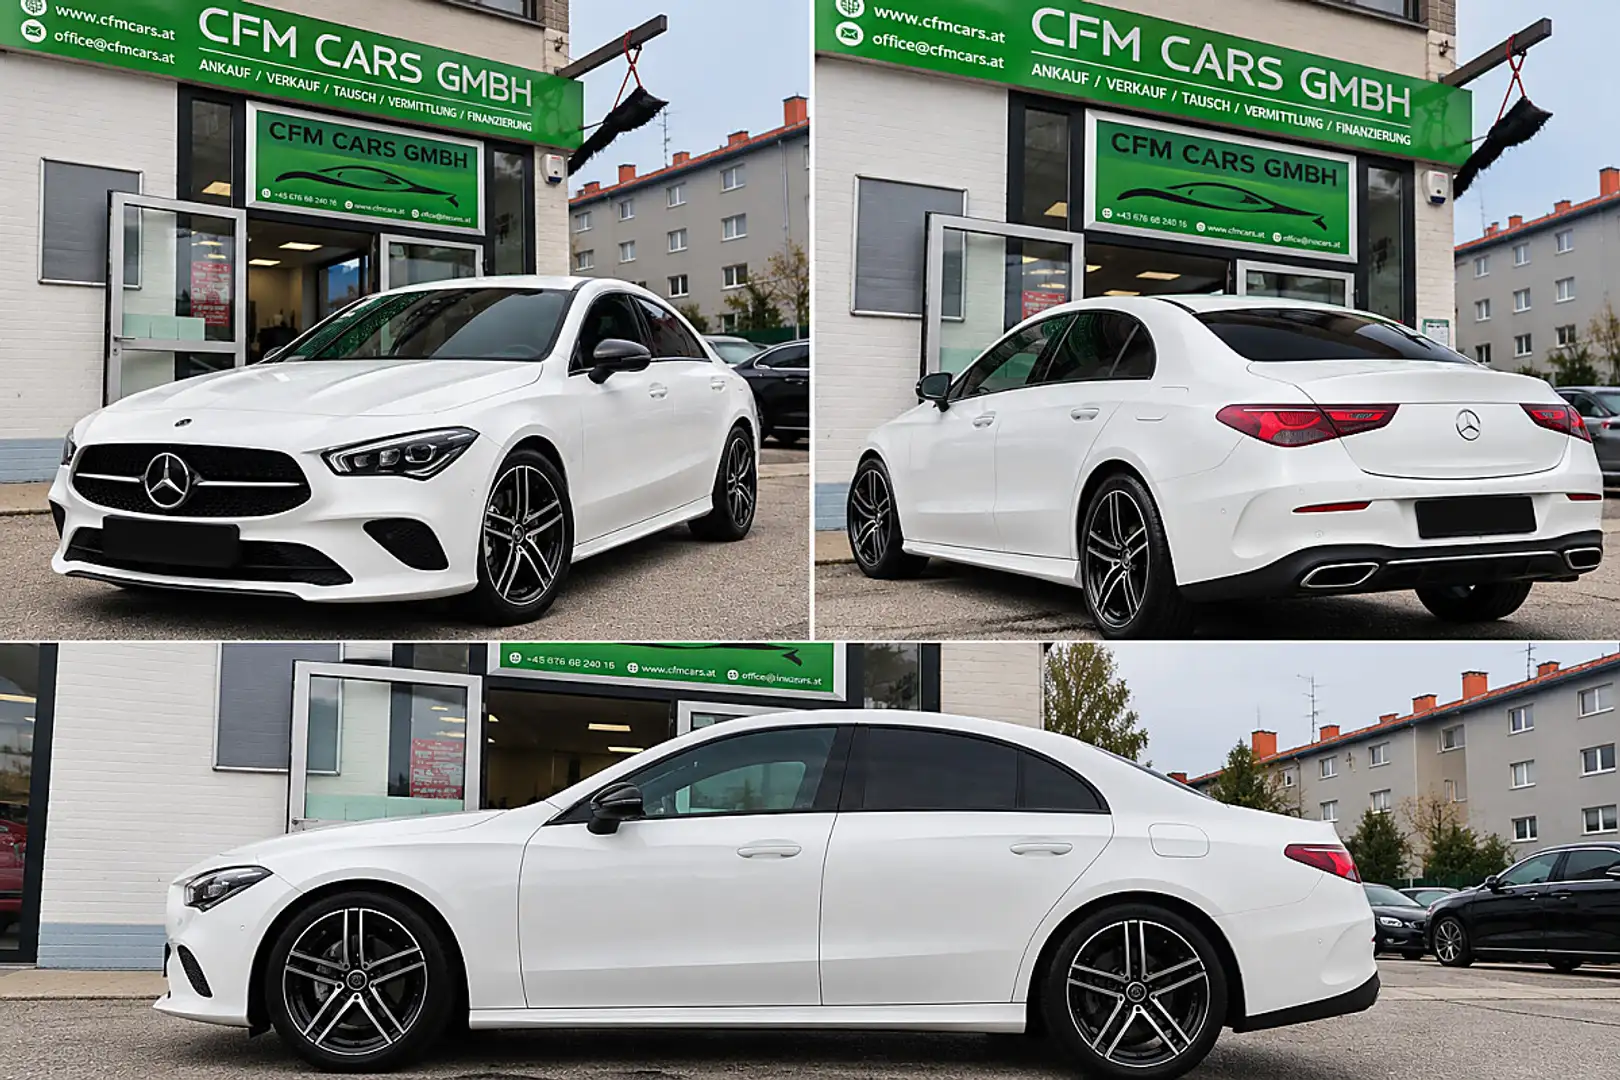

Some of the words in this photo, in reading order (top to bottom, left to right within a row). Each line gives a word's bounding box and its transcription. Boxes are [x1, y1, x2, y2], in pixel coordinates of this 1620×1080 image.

[56, 5, 175, 40] www.cfmcars.at
[874, 6, 1006, 43] www.cfmcars.at
[55, 31, 175, 64] office@cfmcars.at
[199, 7, 297, 58] CFM
[315, 34, 422, 84] CARS
[437, 61, 532, 107] GMBH
[872, 33, 1005, 69] office@cfmcars.at
[1031, 7, 1140, 62] CFM
[1161, 35, 1284, 91] CARS
[1300, 67, 1411, 117] GMBH
[199, 59, 251, 79] ANKAUF
[255, 70, 262, 81] /
[266, 71, 320, 92] VERKAUF
[323, 83, 330, 94] /
[333, 85, 377, 103] TAUSCH
[379, 95, 385, 105] /
[388, 96, 457, 118] VERMITTLUNG
[459, 110, 465, 120] /
[467, 111, 532, 132] FINANZIERUNG
[1031, 63, 1089, 85] ANKAUF
[1094, 75, 1101, 88] /
[1106, 77, 1167, 100] VERKAUF
[1171, 90, 1177, 101] /
[1181, 92, 1230, 112] TAUSCH
[1234, 103, 1240, 114] /
[1244, 103, 1323, 129] VERMITTLUNG
[1326, 120, 1332, 131] /
[1336, 121, 1411, 145] FINANZIERUNG
[269, 121, 324, 146] CFM
[332, 132, 397, 158] CARS
[403, 144, 468, 168] GMBH
[1111, 132, 1172, 160] CFM
[1182, 144, 1255, 174] CARS
[1263, 158, 1337, 187] GMBH
[583, 660, 601, 669] 240
